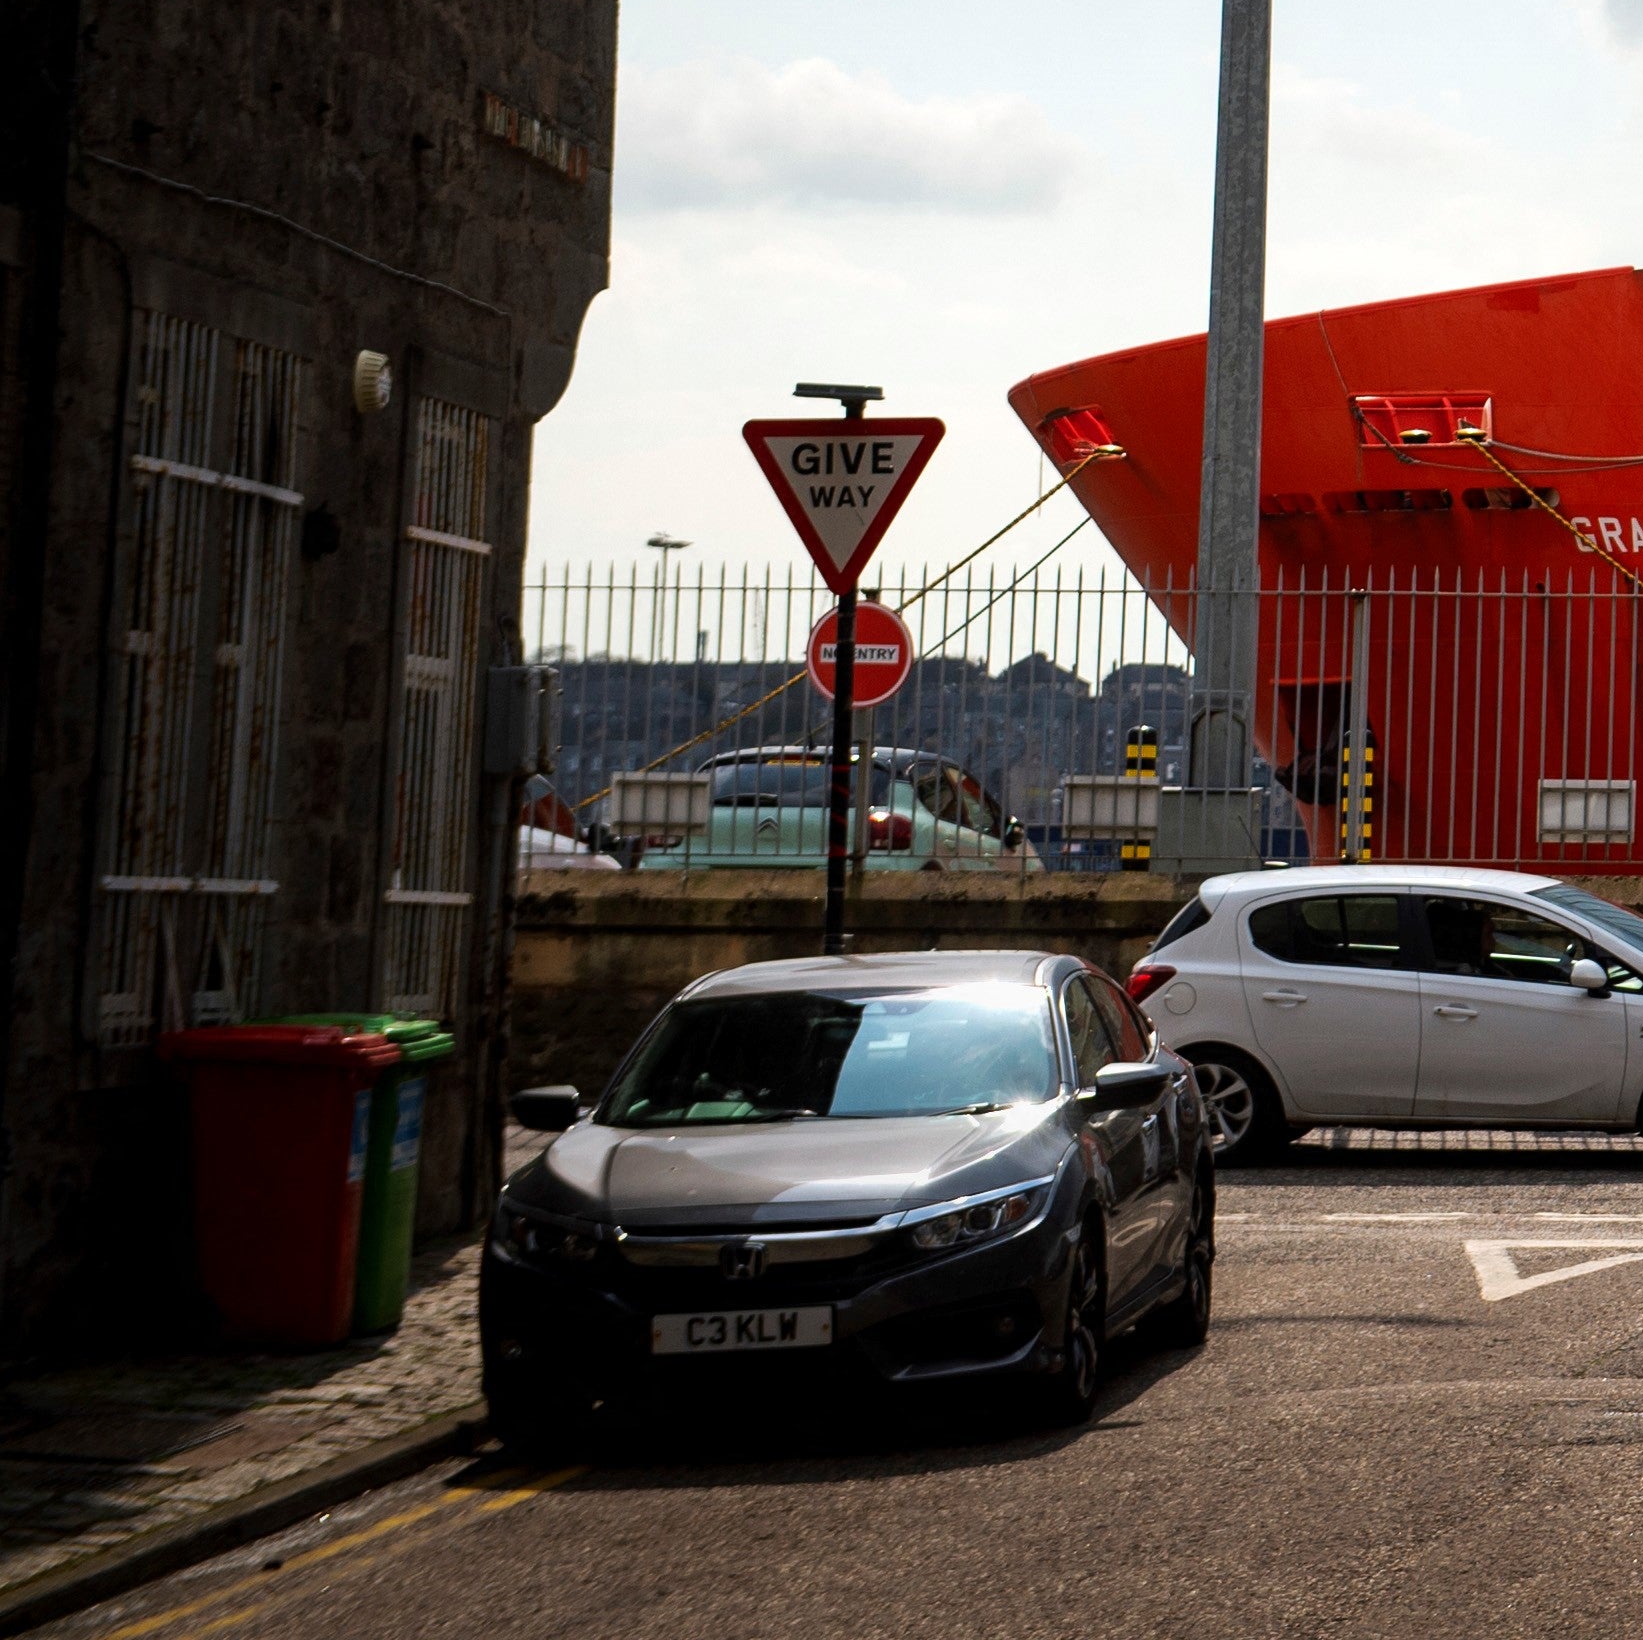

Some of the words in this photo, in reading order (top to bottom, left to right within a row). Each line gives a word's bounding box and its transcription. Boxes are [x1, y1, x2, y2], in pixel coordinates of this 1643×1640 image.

[791, 442, 894, 475] GIVE
[810, 485, 876, 508] WAY
[687, 1315, 727, 1346] C3
[736, 1311, 799, 1343] KLW
